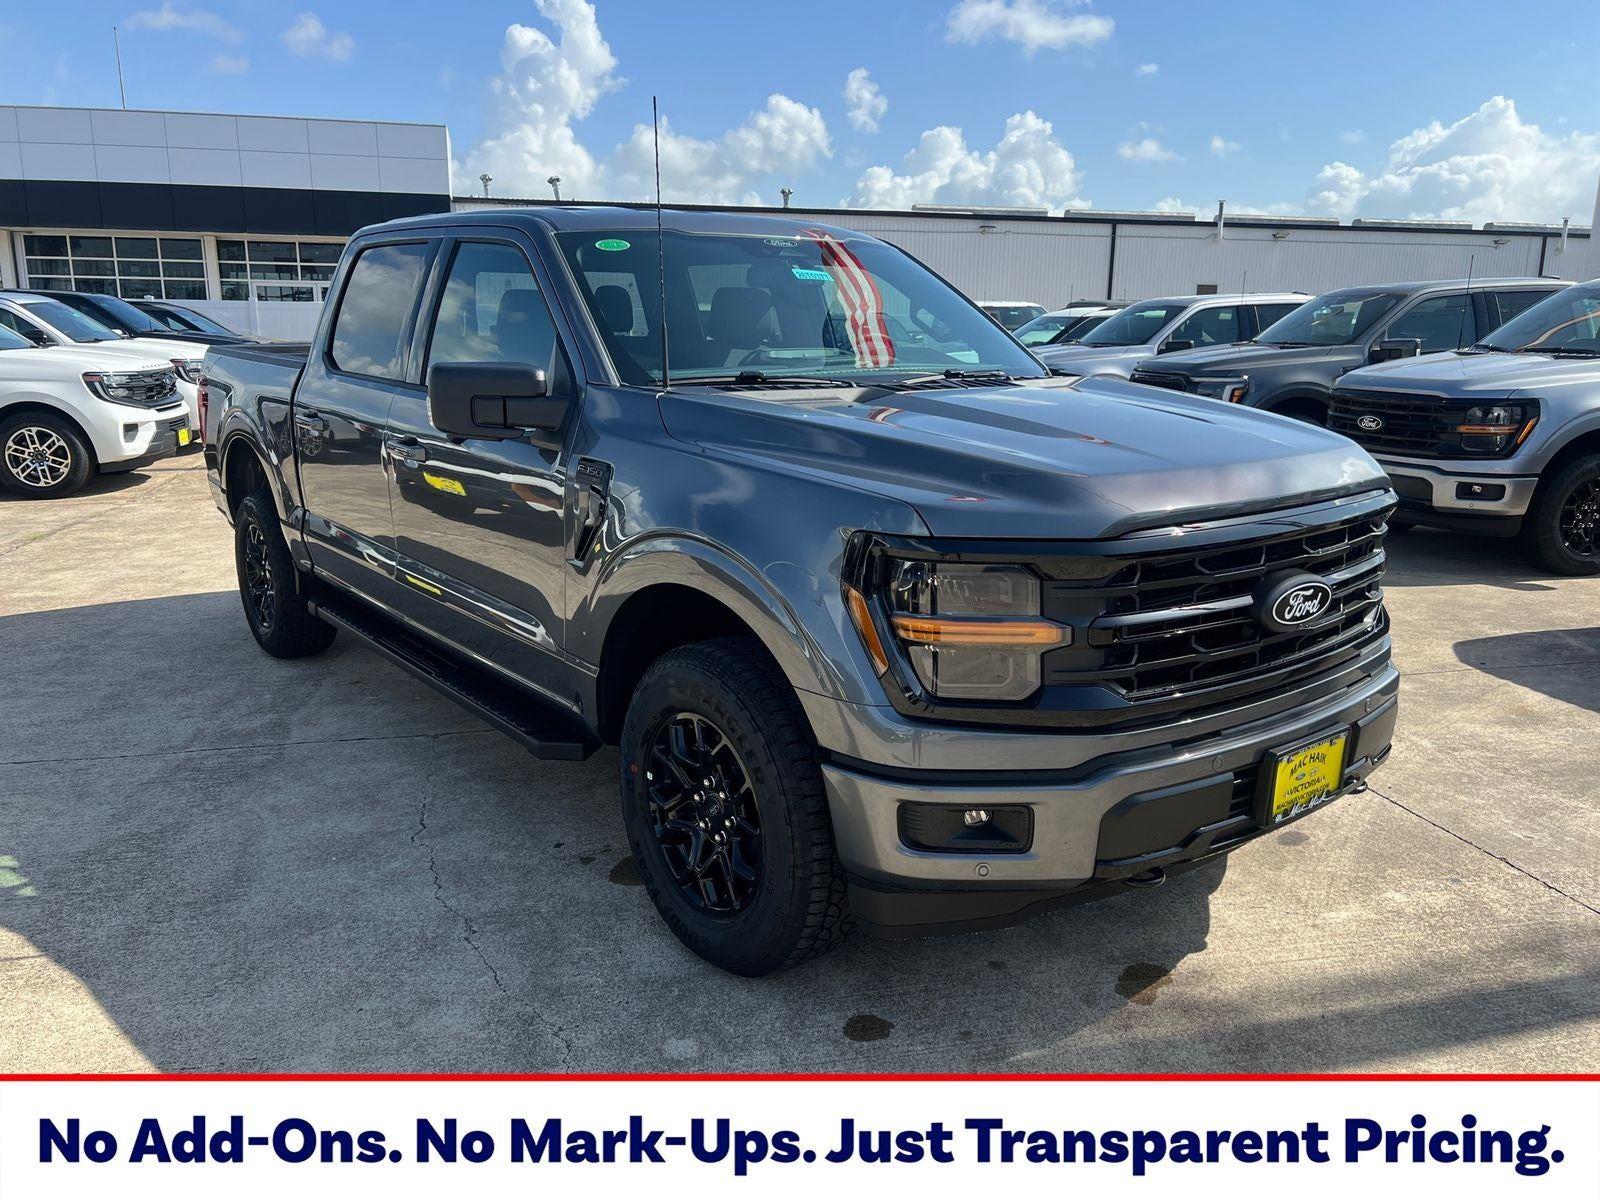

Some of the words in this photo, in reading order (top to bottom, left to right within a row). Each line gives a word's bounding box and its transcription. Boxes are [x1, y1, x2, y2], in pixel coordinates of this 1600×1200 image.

[1361, 417, 1379, 427] Ford
[1284, 588, 1322, 620] Ford
[1289, 755, 1308, 777] MAC
[1308, 752, 1327, 764] HAIK
